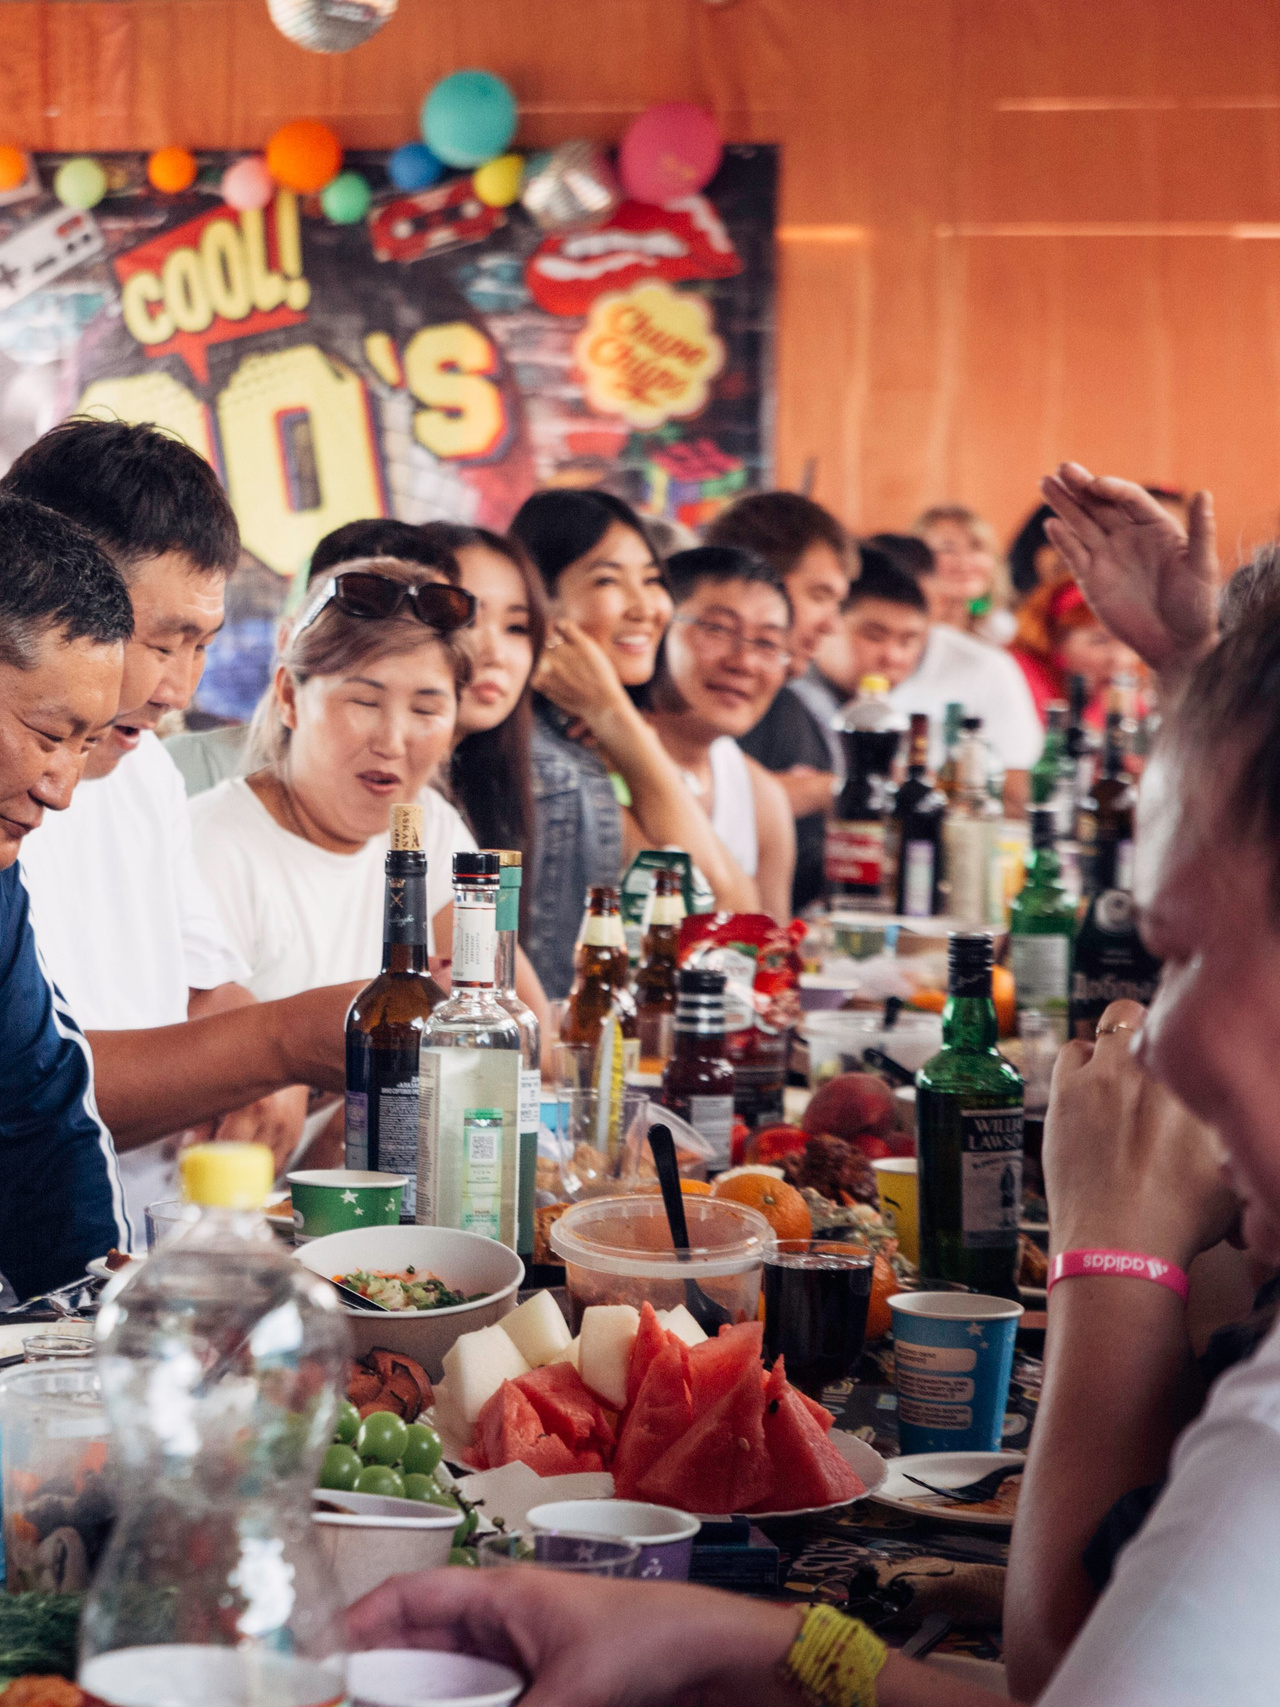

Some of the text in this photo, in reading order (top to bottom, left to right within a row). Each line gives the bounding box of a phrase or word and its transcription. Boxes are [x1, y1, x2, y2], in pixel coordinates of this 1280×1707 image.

[122, 186, 311, 345] COOL!
[402, 810, 410, 851] ASKAN
[973, 1117, 1023, 1135] WILLI
[1083, 1254, 1145, 1272] adidas
